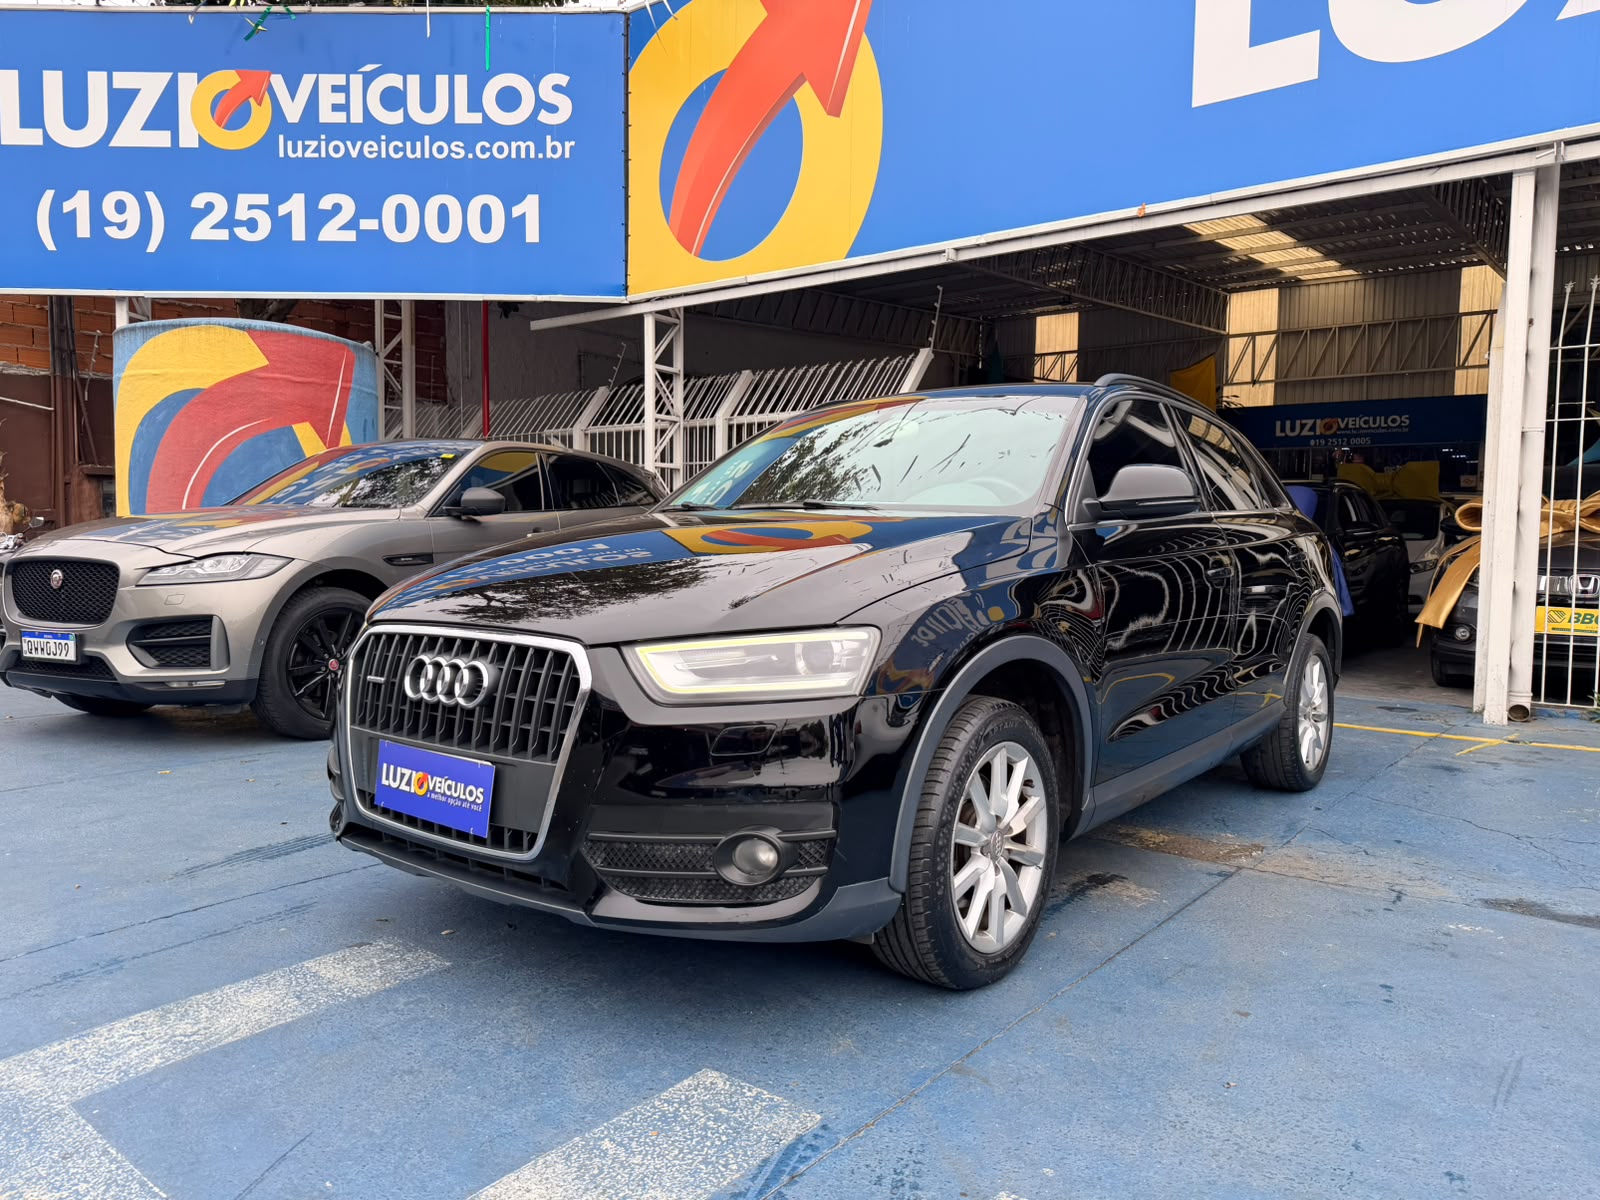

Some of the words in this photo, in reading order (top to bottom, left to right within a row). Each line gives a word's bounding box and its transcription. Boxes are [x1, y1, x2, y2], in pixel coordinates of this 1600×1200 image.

[0, 69, 272, 149] LUZIO
[268, 63, 573, 125] VEÍCULOS
[278, 135, 575, 160] luzioveiculos.com.br
[36, 189, 165, 252] (19)
[190, 193, 541, 243] 2512-0001
[1275, 417, 1338, 437] LUZIO
[1337, 414, 1410, 428] VEÍCULOS
[1328, 437, 1347, 445] 2512
[381, 762, 429, 796] LUZIO
[427, 775, 484, 804] VEÍCULOS
